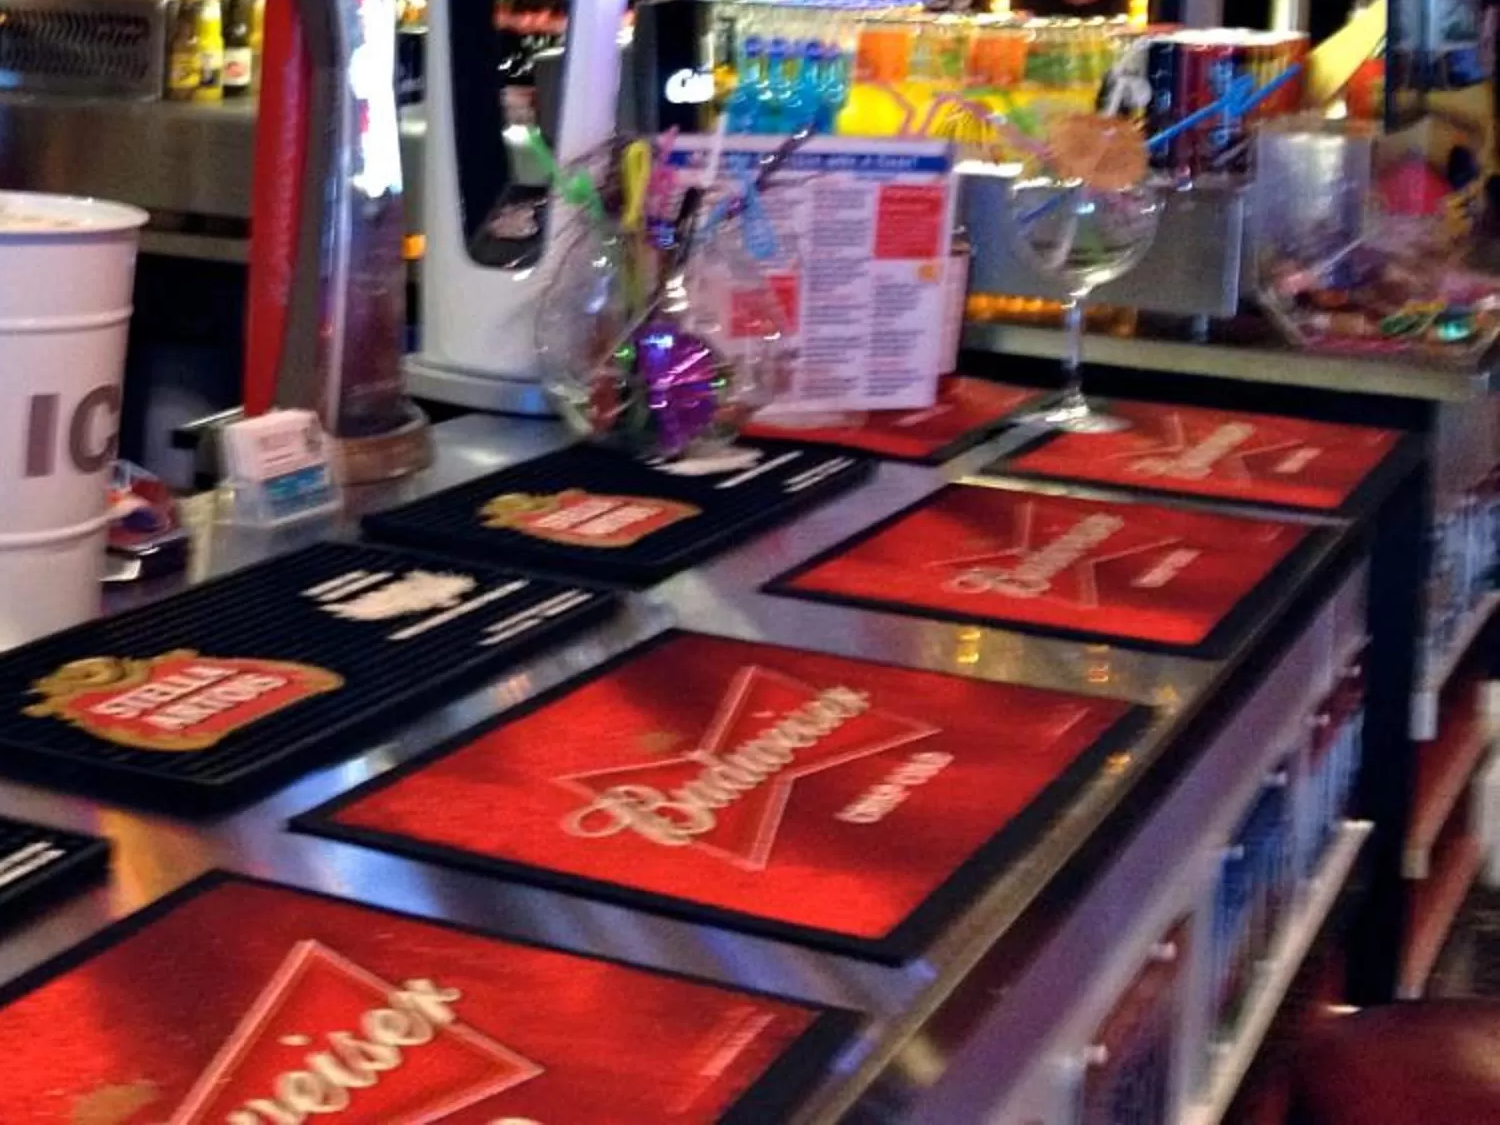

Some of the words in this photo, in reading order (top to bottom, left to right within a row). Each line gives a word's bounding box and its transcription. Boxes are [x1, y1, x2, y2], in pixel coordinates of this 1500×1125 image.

[25, 383, 121, 477] IC
[86, 664, 241, 720] STELLA
[225, 977, 461, 1125] weiser
